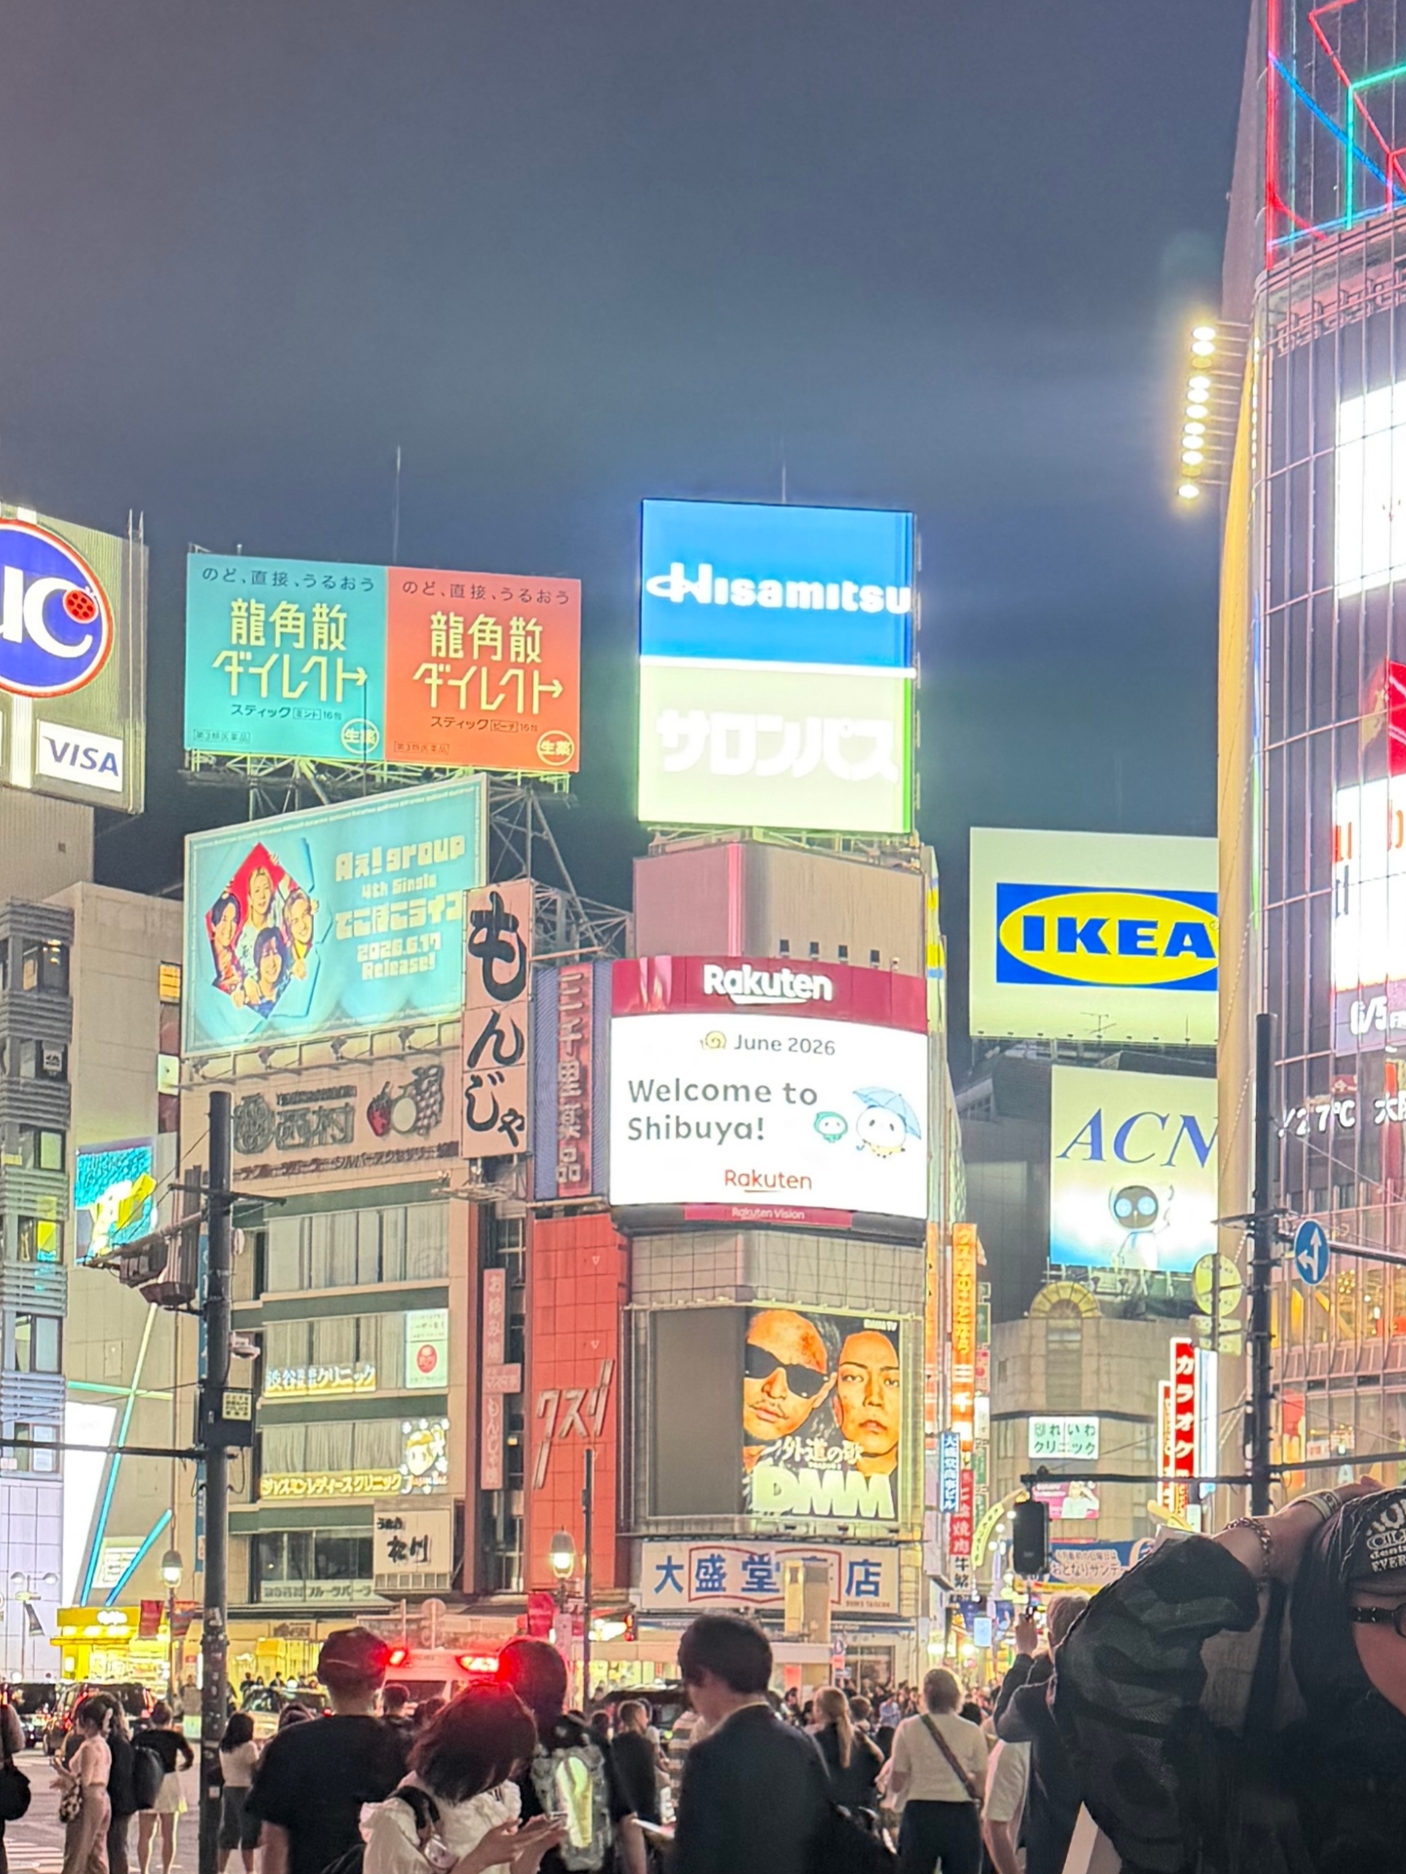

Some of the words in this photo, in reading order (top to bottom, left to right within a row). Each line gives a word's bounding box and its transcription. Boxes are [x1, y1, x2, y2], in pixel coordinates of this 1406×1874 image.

[202, 567, 375, 592] のど、直接、うるおう
[402, 580, 570, 605] のど、直接、うるおう
[646, 562, 912, 614] Hisamitsu
[230, 597, 348, 651] 龍角散
[430, 610, 543, 664] 龍角散
[212, 649, 368, 703] ダイレクト
[412, 662, 564, 715] ダイレクト
[231, 703, 292, 719] スティック
[430, 716, 489, 731] スティック
[42, 735, 119, 777] VISA
[655, 709, 900, 783] サロンパス
[386, 834, 465, 873] group
[1022, 914, 1217, 959] IKEA
[361, 951, 436, 981] Release!
[703, 965, 834, 1003] Rakuten
[467, 890, 528, 1149] もんじゃ
[1350, 995, 1388, 1036] 6/5
[734, 1033, 783, 1052] June
[787, 1037, 836, 1056] 2026
[555, 972, 584, 1183] 三千里薬品
[628, 1078, 772, 1103] Welcome
[782, 1082, 818, 1106] to
[627, 1113, 765, 1146] Shibuya!
[724, 1169, 813, 1190] Rakuten
[732, 1206, 773, 1220] Rakuten
[774, 1208, 805, 1220] Vision
[531, 1358, 616, 1489] クスリ
[1174, 1354, 1195, 1460] カラオケ
[1050, 1424, 1097, 1437] れいわ
[752, 1463, 896, 1520] DMM
[654, 1553, 883, 1598] 大盛堂店
